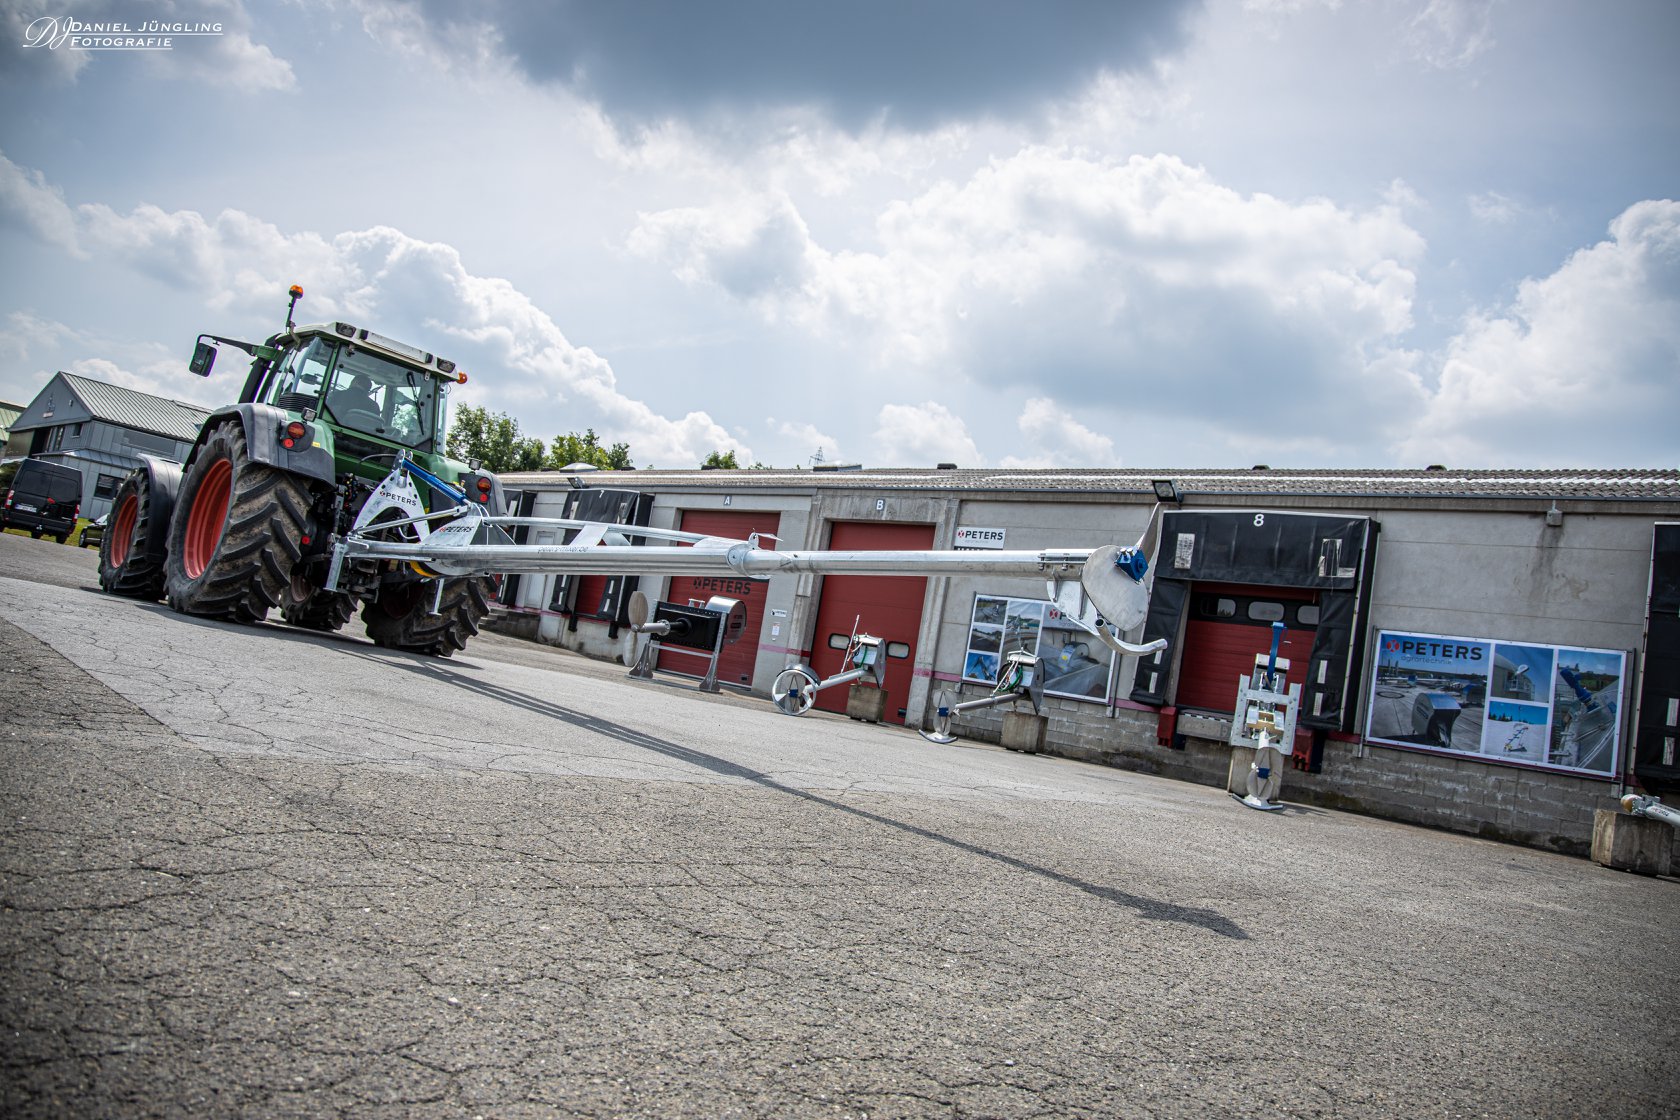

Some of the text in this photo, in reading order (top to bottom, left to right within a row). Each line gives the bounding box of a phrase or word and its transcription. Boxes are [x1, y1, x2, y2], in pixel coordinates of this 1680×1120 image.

[385, 492, 417, 507] PETERS
[724, 496, 731, 505] A
[876, 499, 885, 511] B
[1253, 513, 1265, 527] 8
[965, 530, 1004, 541] PETERS
[702, 578, 752, 595] PETERS
[1402, 640, 1483, 661] PETERS
